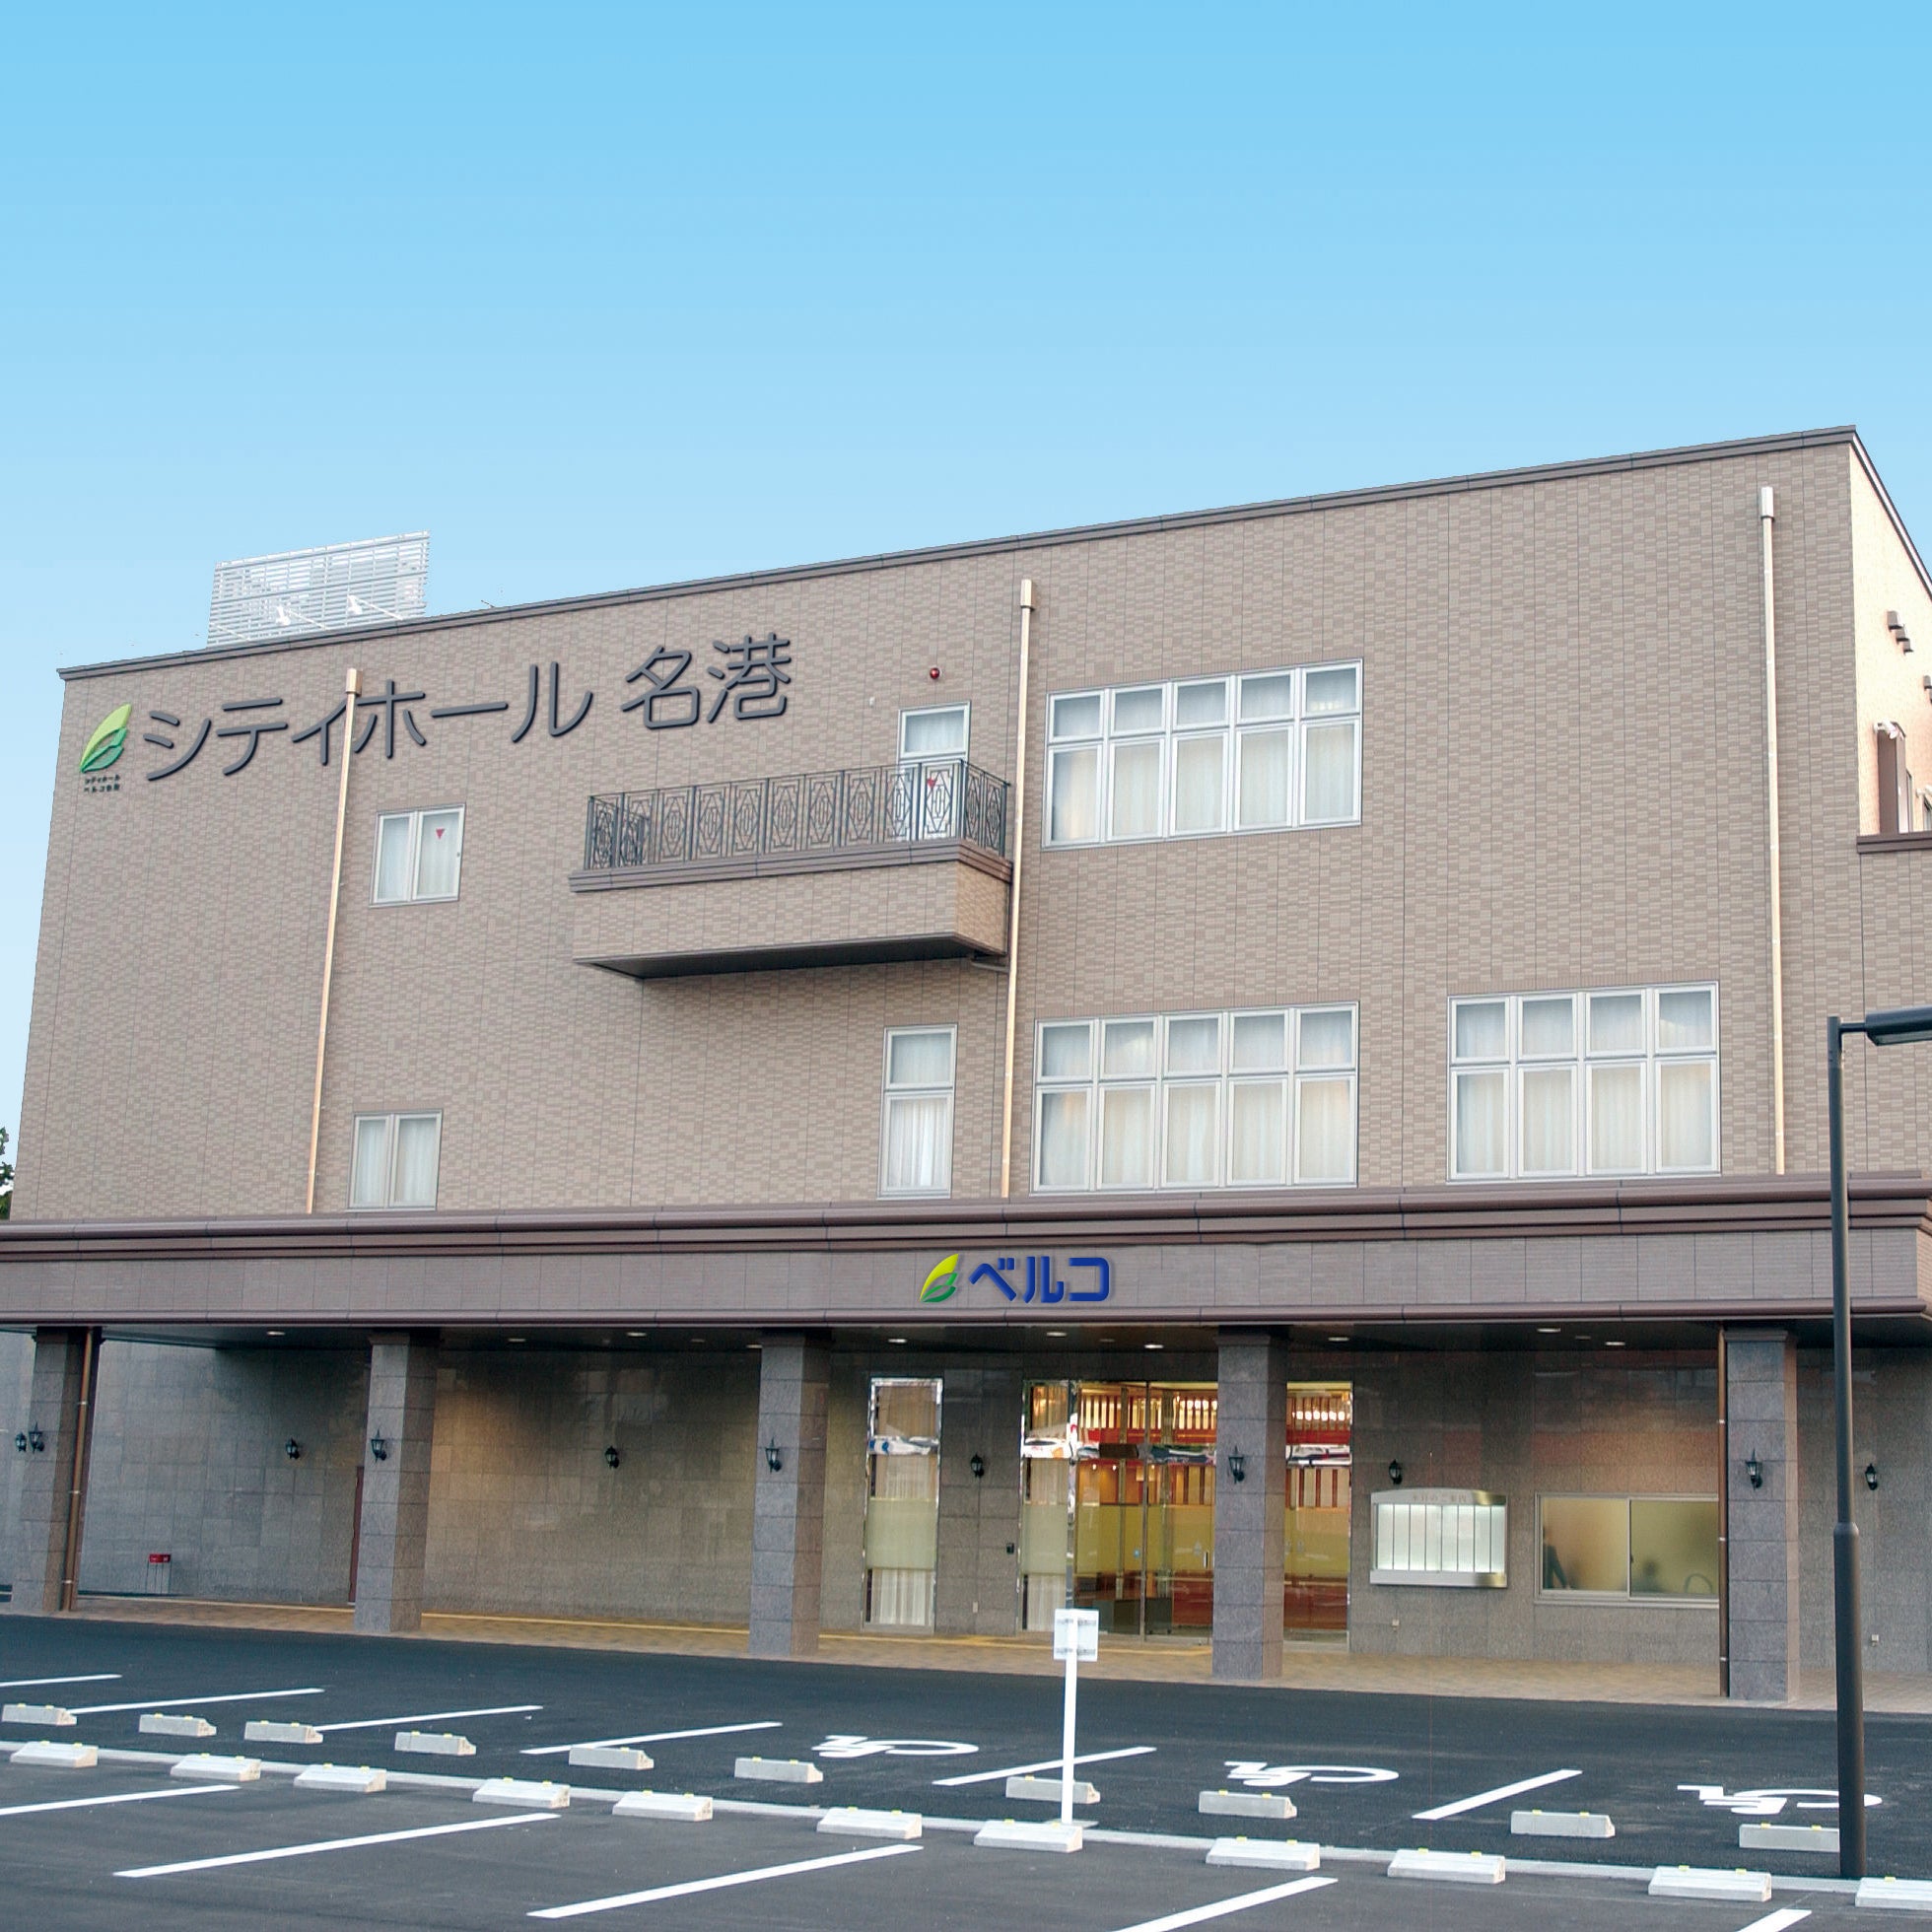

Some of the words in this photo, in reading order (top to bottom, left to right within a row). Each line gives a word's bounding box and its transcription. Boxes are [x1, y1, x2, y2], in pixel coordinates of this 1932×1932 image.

[621, 632, 792, 729] 名港
[968, 1256, 1110, 1304] ベルコ
